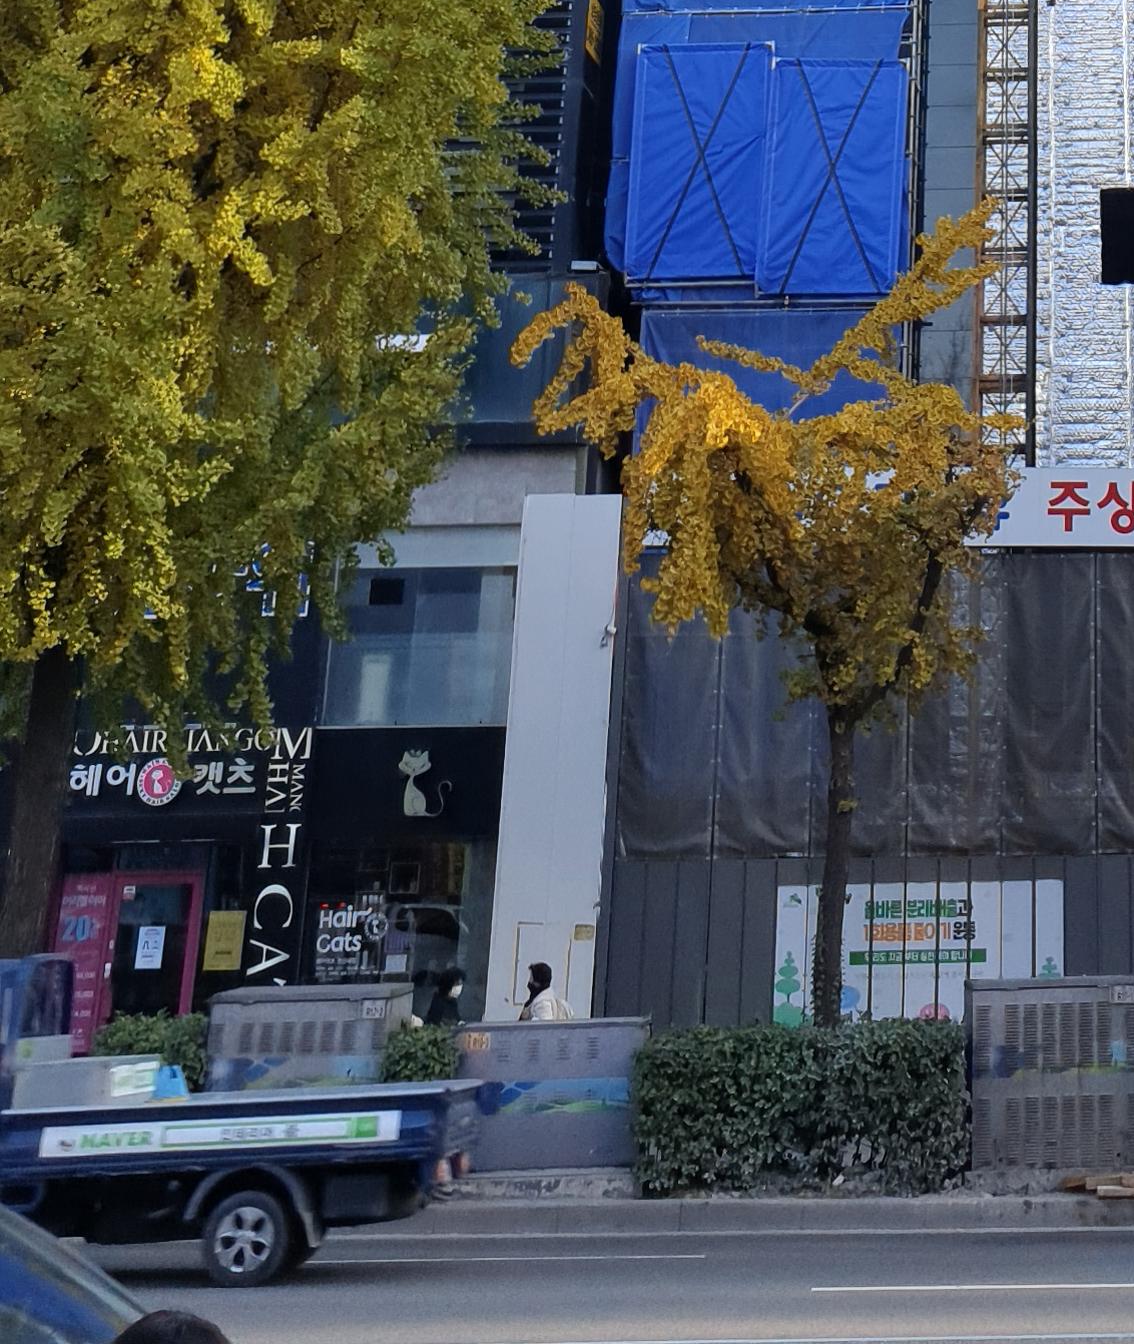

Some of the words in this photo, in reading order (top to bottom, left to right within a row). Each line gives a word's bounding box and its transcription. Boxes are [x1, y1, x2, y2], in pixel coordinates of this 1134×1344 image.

[69, 763, 137, 797] 헤어
[319, 904, 373, 929] Hair
[316, 932, 363, 953] Cats
[80, 1130, 153, 1150] NAVER
